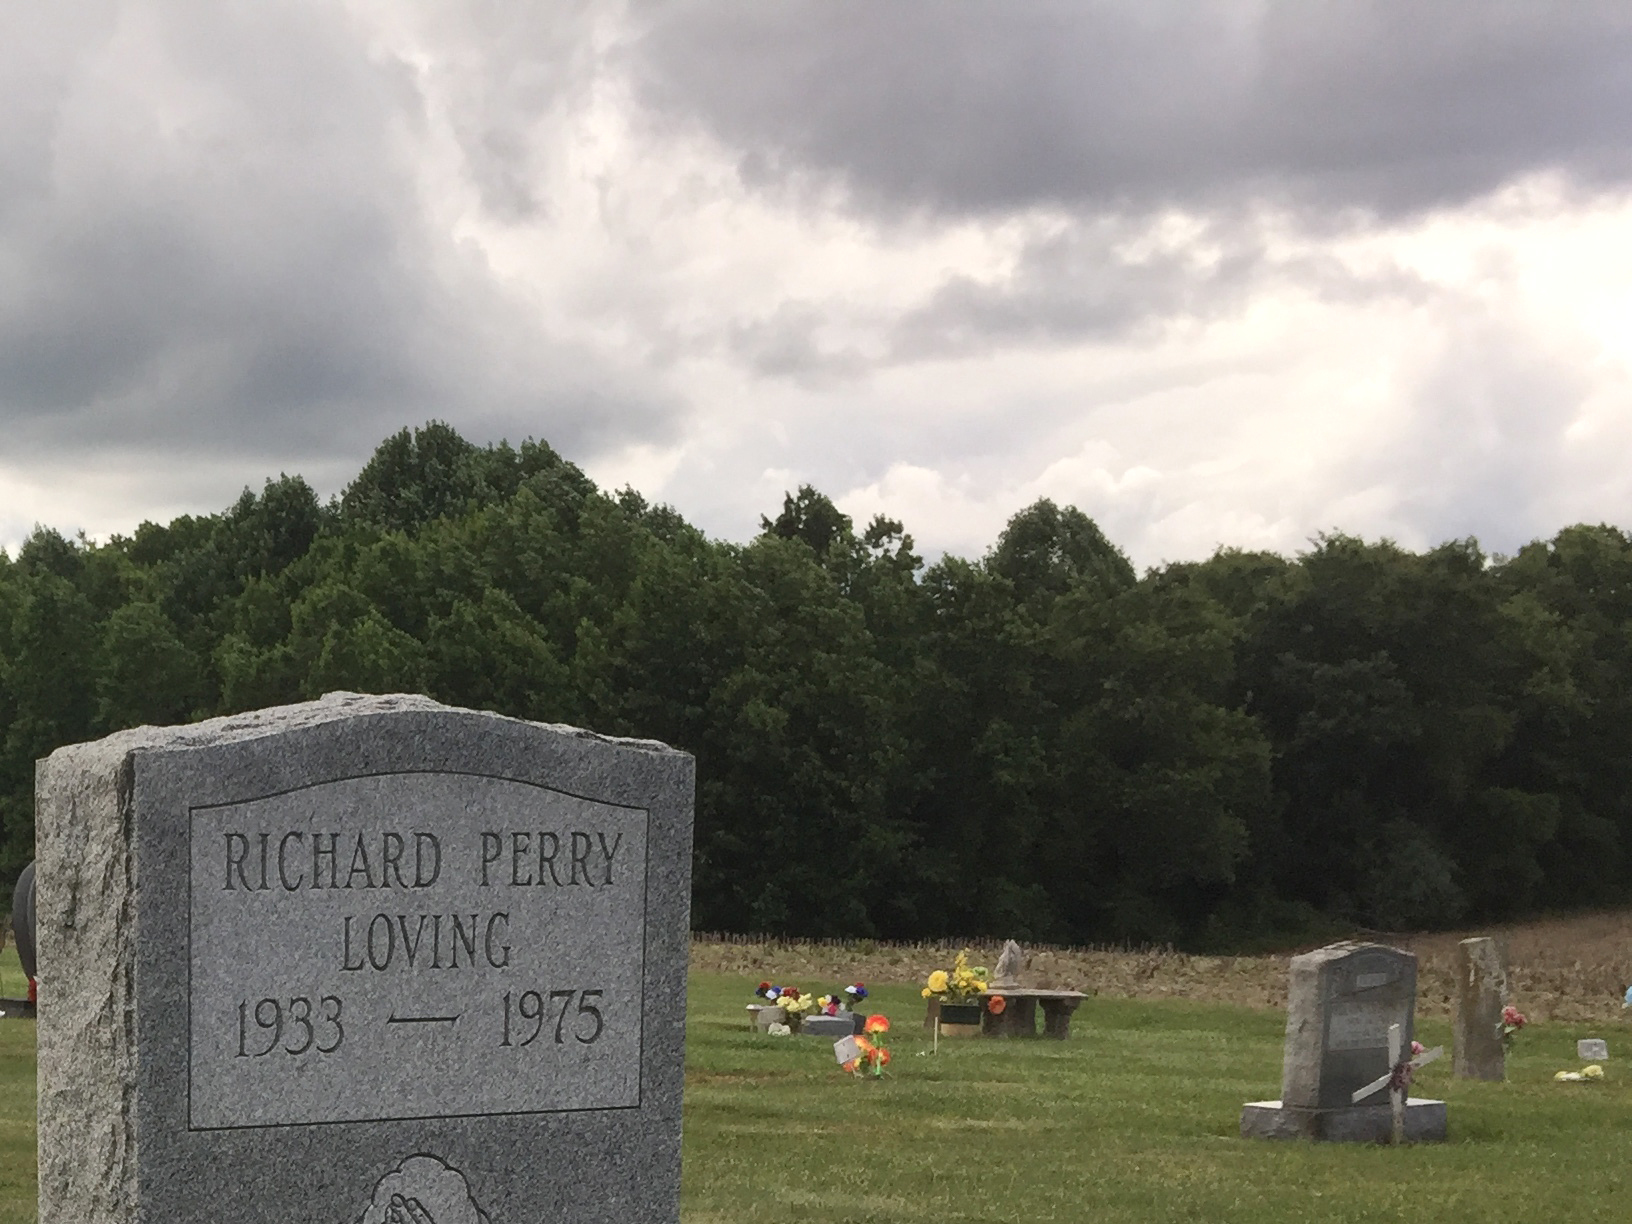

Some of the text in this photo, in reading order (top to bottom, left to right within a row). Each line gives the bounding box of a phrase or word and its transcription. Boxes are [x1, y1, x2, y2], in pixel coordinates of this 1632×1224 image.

[222, 830, 624, 893] RICHARD PERRY
[339, 911, 511, 972] LOVING
[235, 994, 346, 1058] 1933
[499, 988, 605, 1048] 1975
